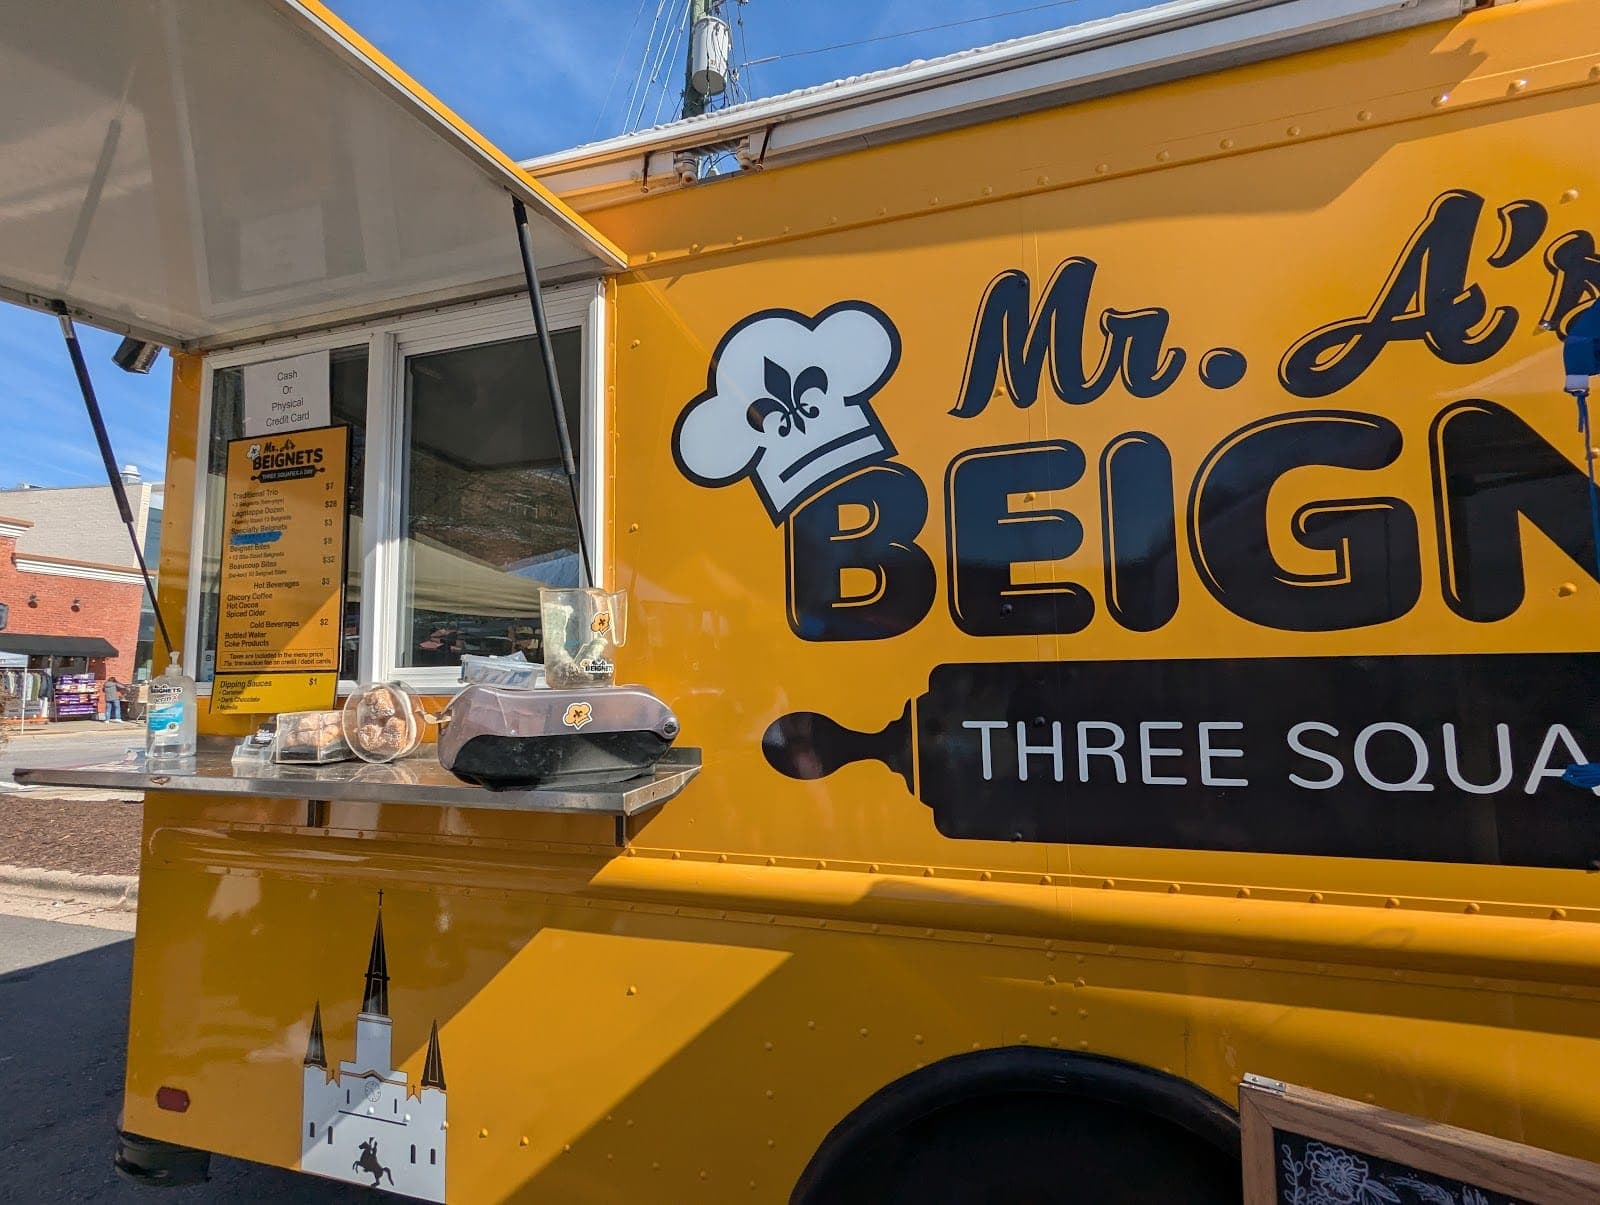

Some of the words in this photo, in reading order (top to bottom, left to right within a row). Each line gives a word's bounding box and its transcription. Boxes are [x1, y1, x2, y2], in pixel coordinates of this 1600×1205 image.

[948, 256, 1246, 419] Mr.
[277, 370, 297, 381] Cash
[282, 386, 293, 394] Or
[272, 398, 303, 412] Physical
[266, 415, 288, 427] Credit
[290, 412, 309, 422] Card
[264, 442, 279, 454] Mr.
[253, 448, 323, 470] BEIGNETS
[234, 490, 264, 499] Traditional
[221, 680, 246, 689] Dipping
[309, 678, 317, 686] $1
[962, 720, 1249, 788] THREE
